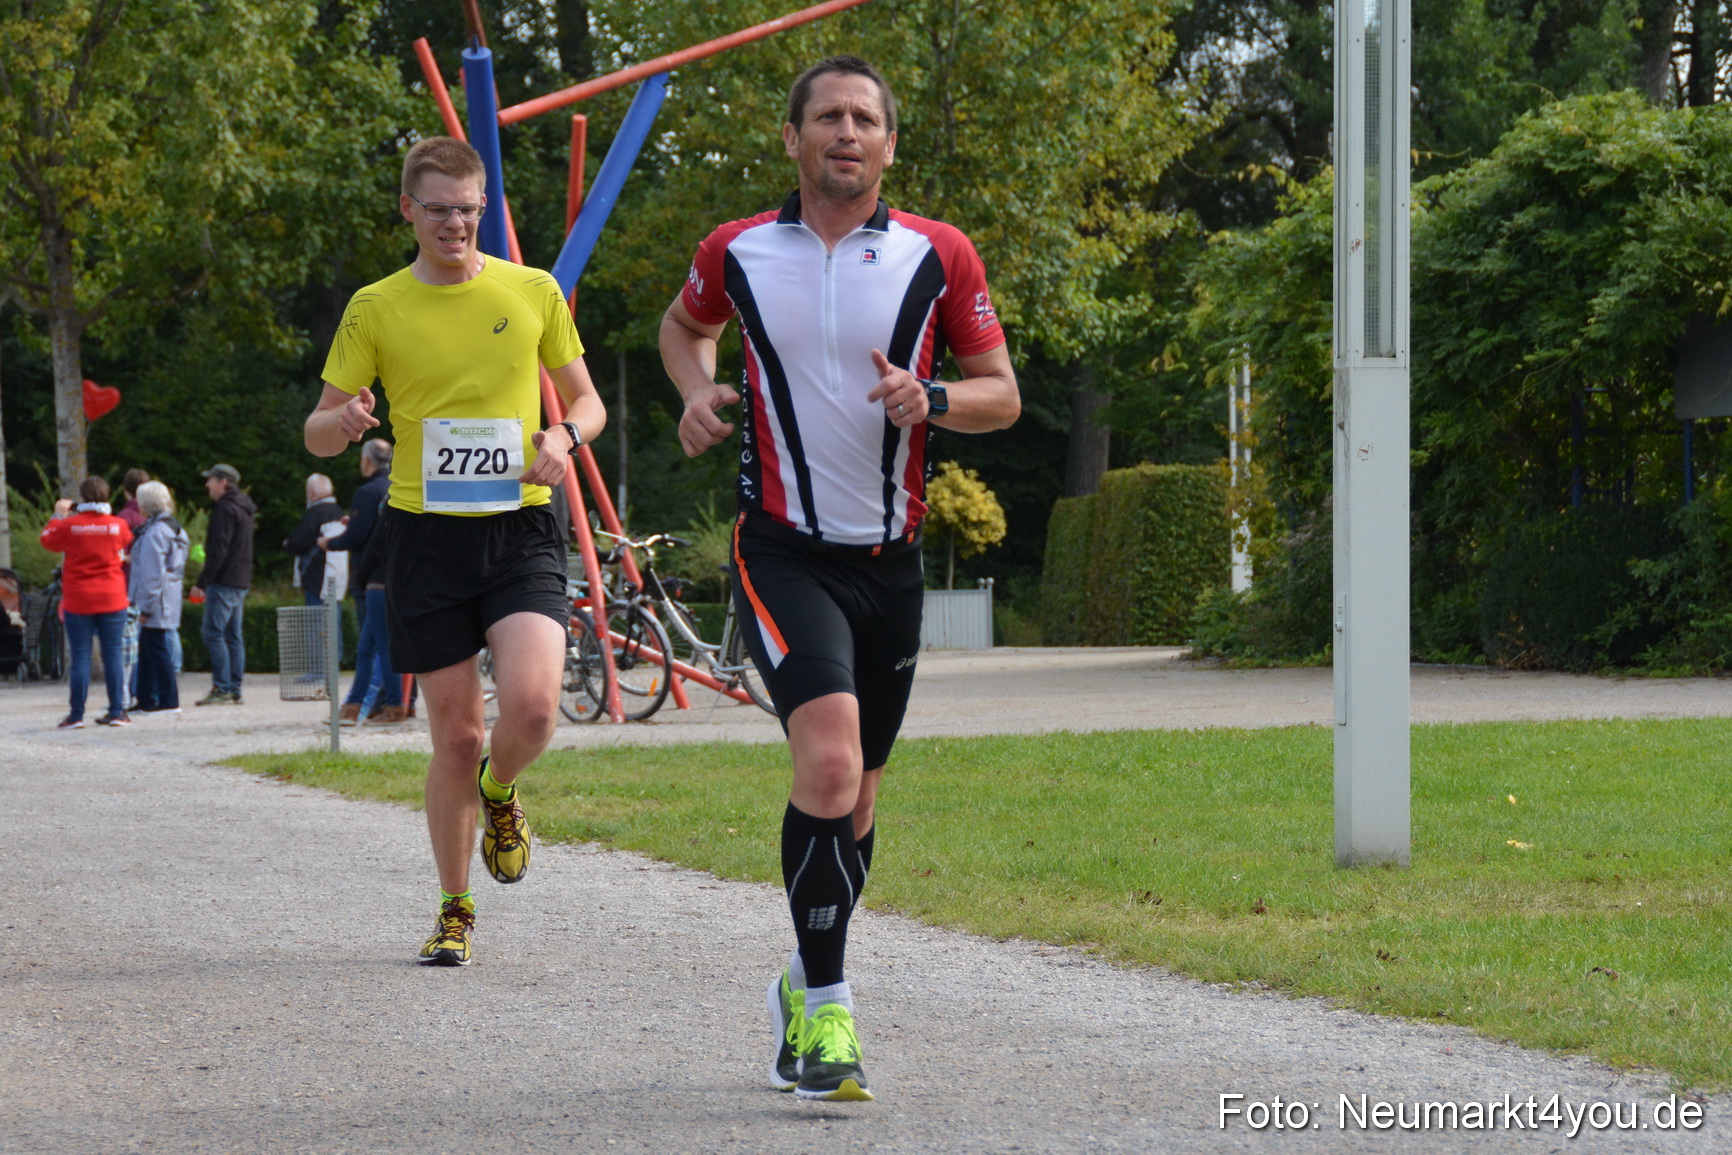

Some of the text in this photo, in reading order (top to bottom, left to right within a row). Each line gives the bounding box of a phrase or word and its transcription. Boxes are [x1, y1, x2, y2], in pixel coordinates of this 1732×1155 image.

[460, 427, 496, 436] BOCK
[438, 447, 509, 475] 2720
[807, 920, 834, 931] cep
